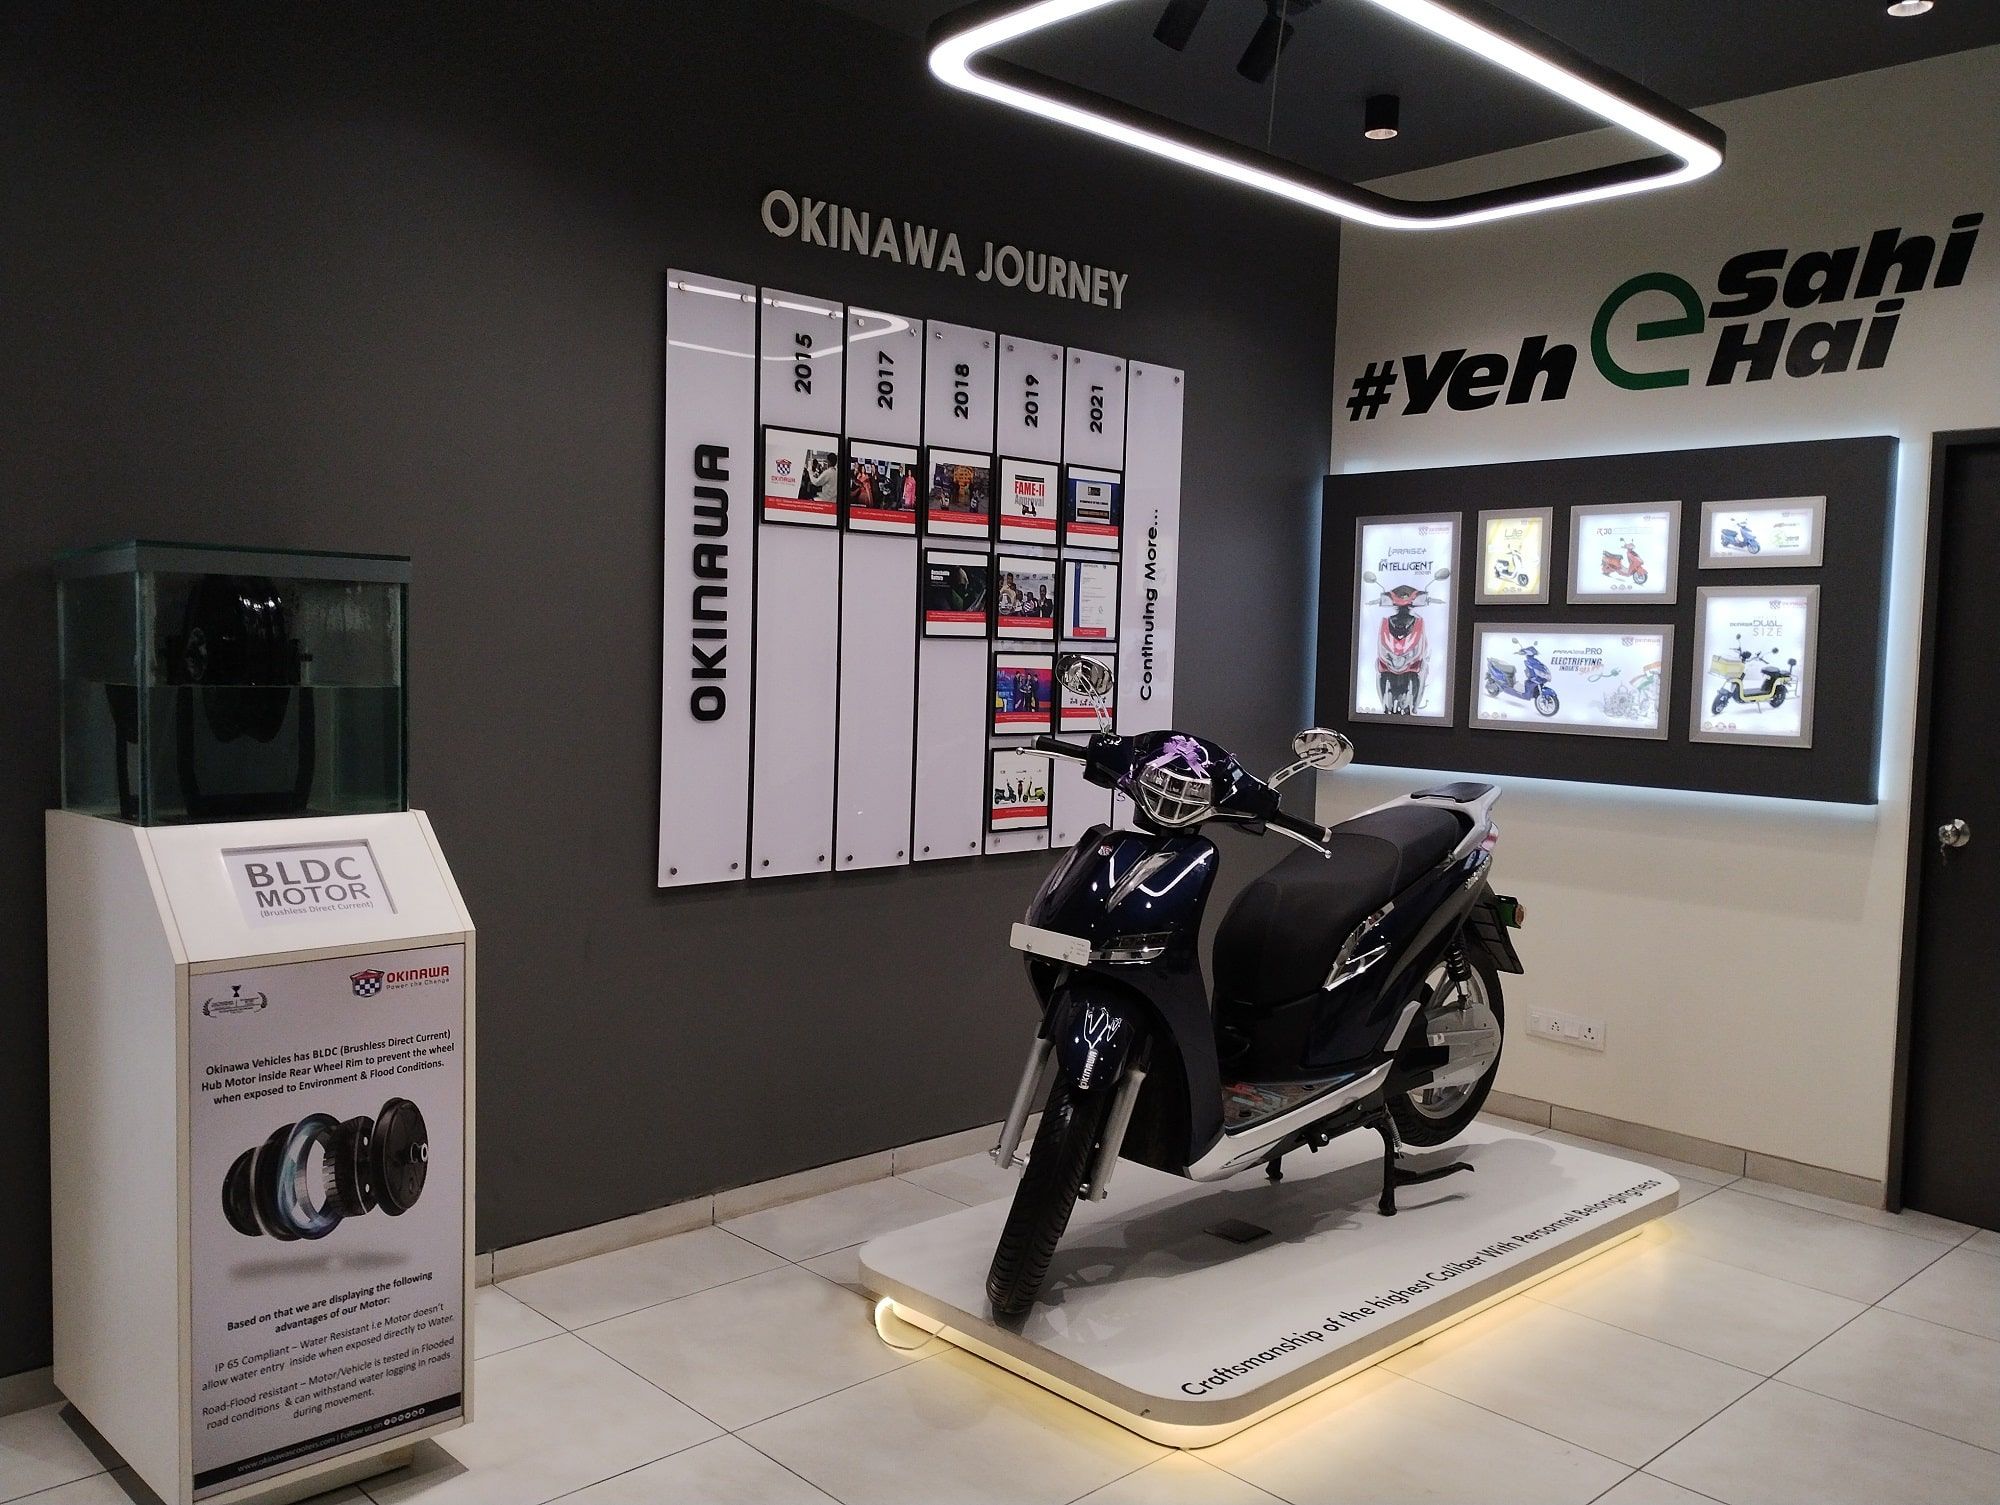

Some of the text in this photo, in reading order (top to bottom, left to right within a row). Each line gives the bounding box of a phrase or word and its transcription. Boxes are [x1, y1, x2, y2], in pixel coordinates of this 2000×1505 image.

[761, 189, 1129, 310] OKINAWA JOURNEY
[795, 333, 812, 395] 2015
[1346, 272, 1705, 422] #Yeh e
[1705, 298, 1905, 387] Hai
[878, 350, 894, 410] 2017
[954, 363, 970, 420] 2018
[1024, 374, 1039, 428] 2019
[1090, 384, 1104, 434] 2021
[1014, 481, 1045, 497] FAME-II
[690, 443, 730, 722] OKINAWA
[1379, 561, 1434, 572] INTELLIGENT
[1140, 509, 1159, 701] Continuing More...
[1753, 628, 1783, 636] SIZE
[1551, 657, 1603, 666] ELECTRIFYING
[244, 856, 362, 888] BLDC
[255, 882, 371, 908] MOTOR
[260, 901, 374, 918] (Brushless Direct Current)
[386, 965, 450, 983] OKINAWA
[201, 1042, 455, 1092] Hub Motor inside Rear Wheel Rim to prevent the wheel
[206, 1029, 451, 1075] Okinawa Vehicles has BLDC (Brushless Direct Current)
[213, 1060, 445, 1105] when exposed to Environment & Flood Conditions.
[227, 1271, 433, 1331] Based on that we are displaying the following
[1181, 1179, 1662, 1396] Craftsmanship of the highest Caliber With Personnel Belongingness
[275, 1297, 390, 1333] advantages of our Motor:
[202, 1378, 229, 1392] allow
[230, 1369, 258, 1383] water
[260, 1362, 285, 1375] entry
[289, 1353, 317, 1367] inside
[319, 1344, 343, 1359] when
[345, 1333, 382, 1351] exposed
[383, 1325, 415, 1341] directly
[417, 1321, 427, 1331] to
[214, 1362, 225, 1373] IP
[227, 1358, 240, 1370] 65
[241, 1346, 290, 1366] Compliant
[300, 1335, 328, 1349] Water
[330, 1324, 369, 1342] Resistant
[384, 1312, 411, 1327] Motor
[202, 1393, 257, 1416] Road-Flood
[258, 1382, 298, 1400] resistant
[308, 1360, 372, 1386] Motor/Vehicle
[374, 1358, 381, 1367] is
[383, 1349, 410, 1364] tested
[411, 1346, 420, 1356] in
[421, 1336, 455, 1353] Flooded
[206, 1351, 451, 1430] road conditions & can withstand water logging in roads
[293, 1388, 375, 1419] during movement.
